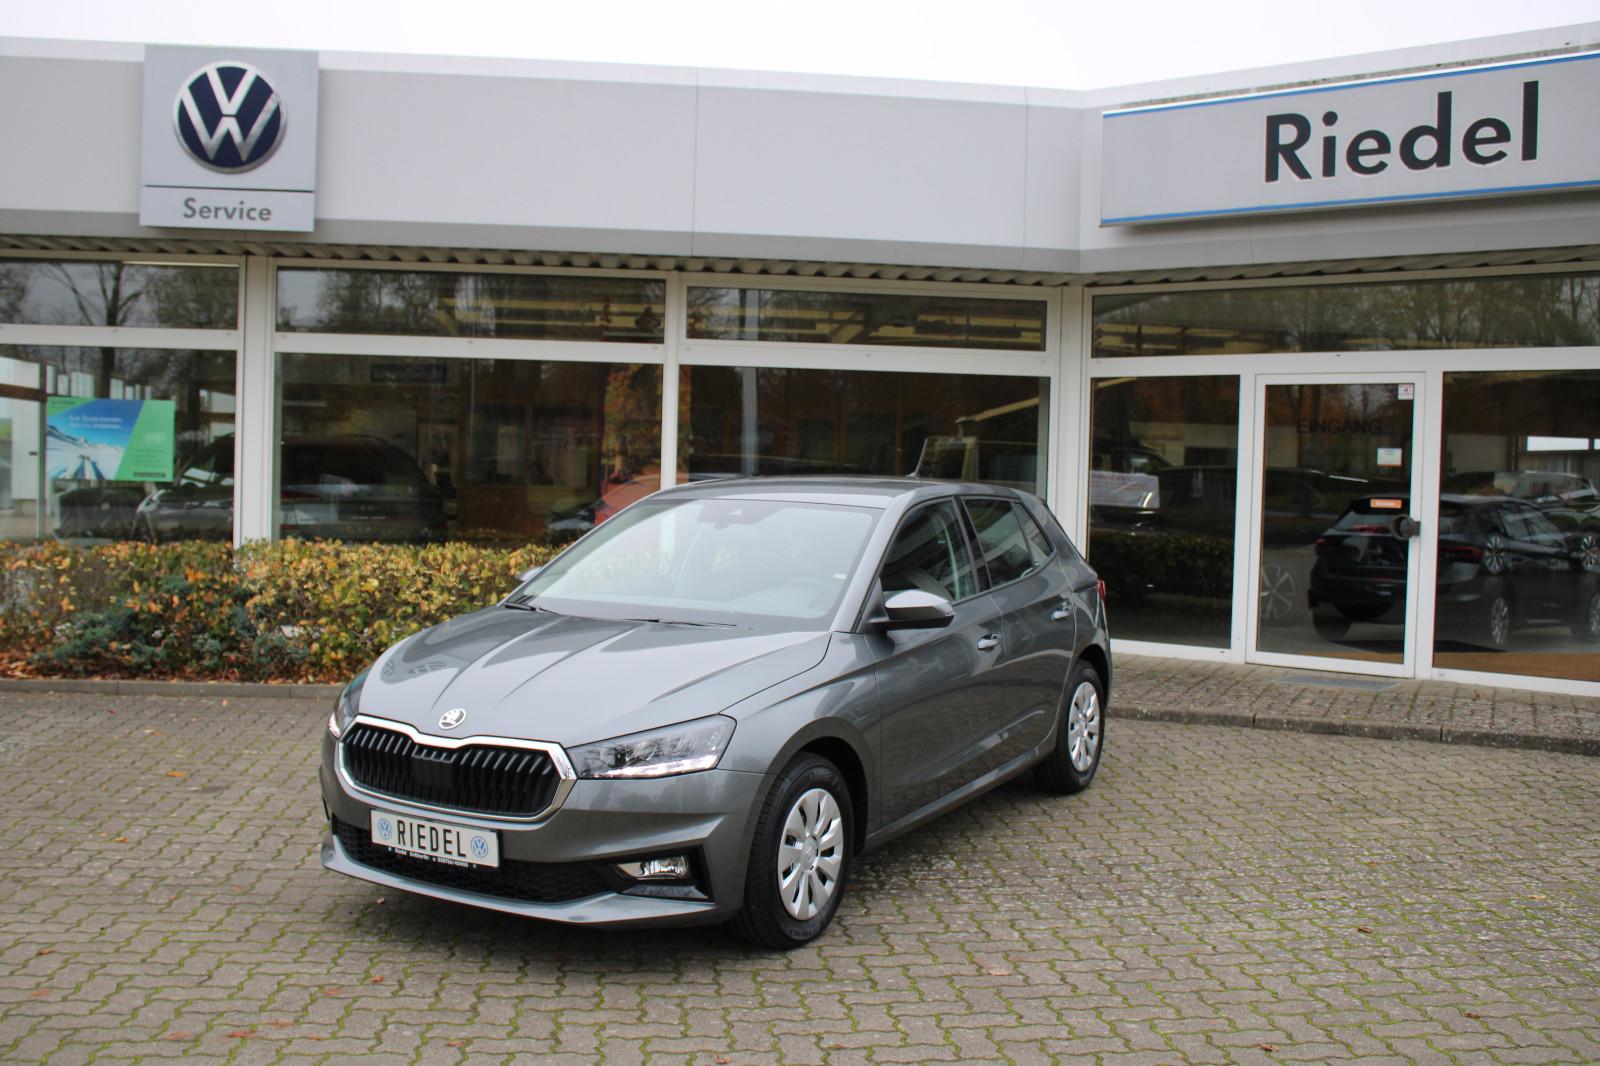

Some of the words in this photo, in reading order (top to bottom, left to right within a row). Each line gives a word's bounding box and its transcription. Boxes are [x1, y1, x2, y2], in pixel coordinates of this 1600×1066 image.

[175, 62, 286, 172] VW
[1264, 80, 1539, 183] Riedel
[183, 197, 272, 222] Service
[1297, 420, 1381, 435] EINGANG
[397, 820, 466, 857] RIEDEL
